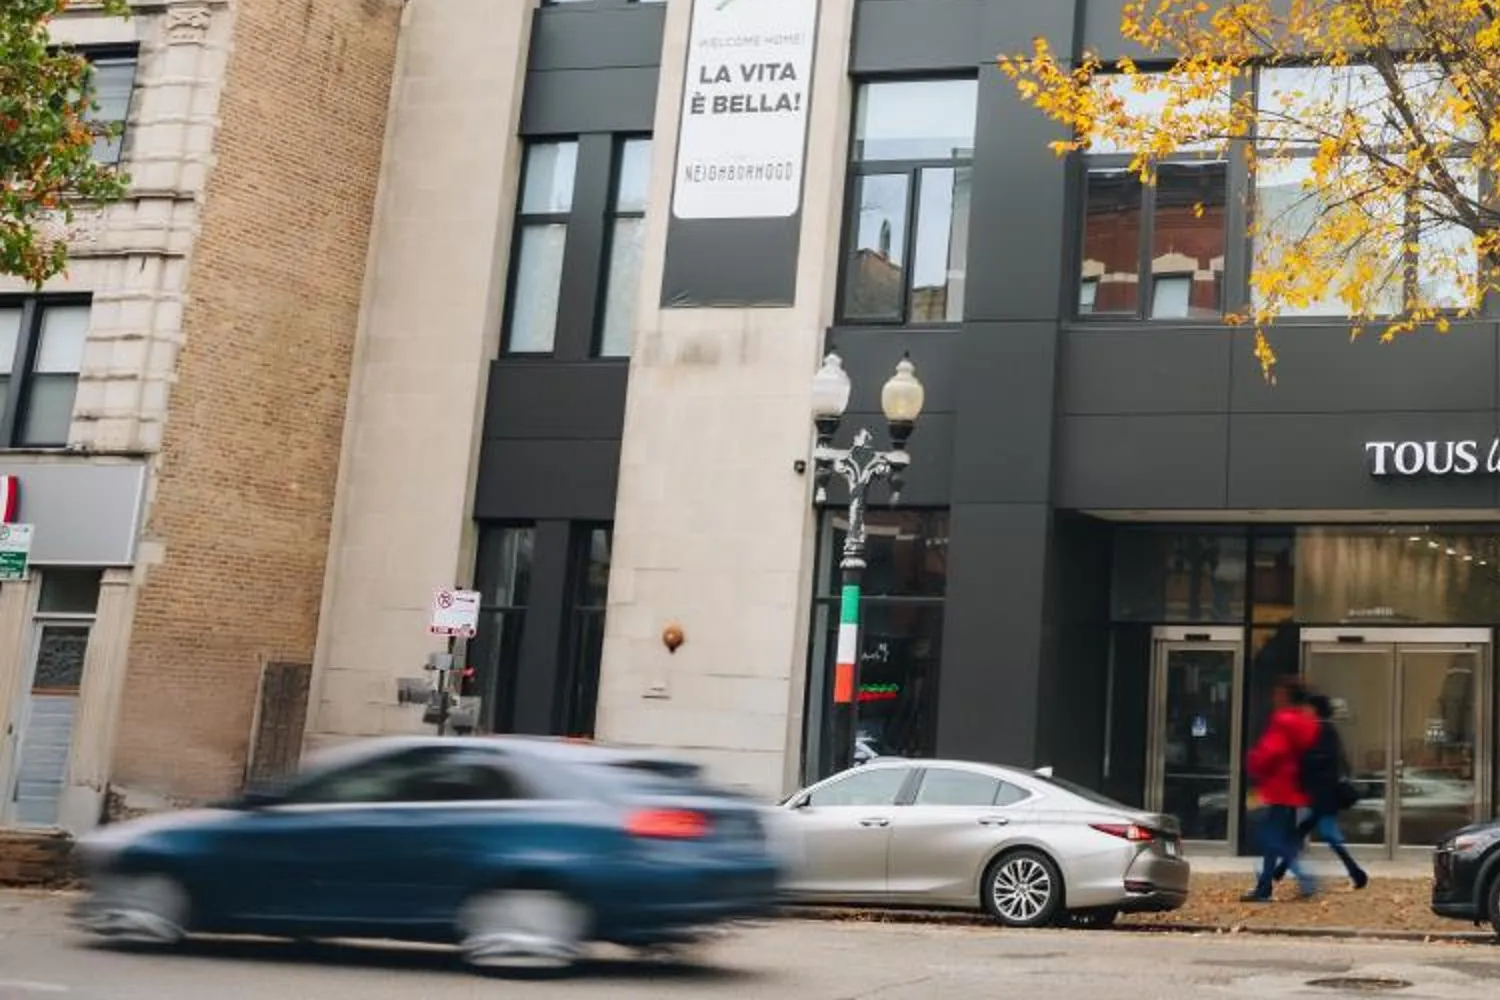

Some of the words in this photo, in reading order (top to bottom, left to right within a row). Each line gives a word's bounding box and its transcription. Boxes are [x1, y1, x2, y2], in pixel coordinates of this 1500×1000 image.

[699, 34, 760, 48] WELCOME
[700, 64, 732, 84] LA
[740, 62, 796, 82] VITA
[690, 91, 705, 114] È
[712, 92, 801, 114] BELLA!
[685, 161, 793, 183] NEIGHBORHOOD
[1365, 440, 1478, 475] TOUS
